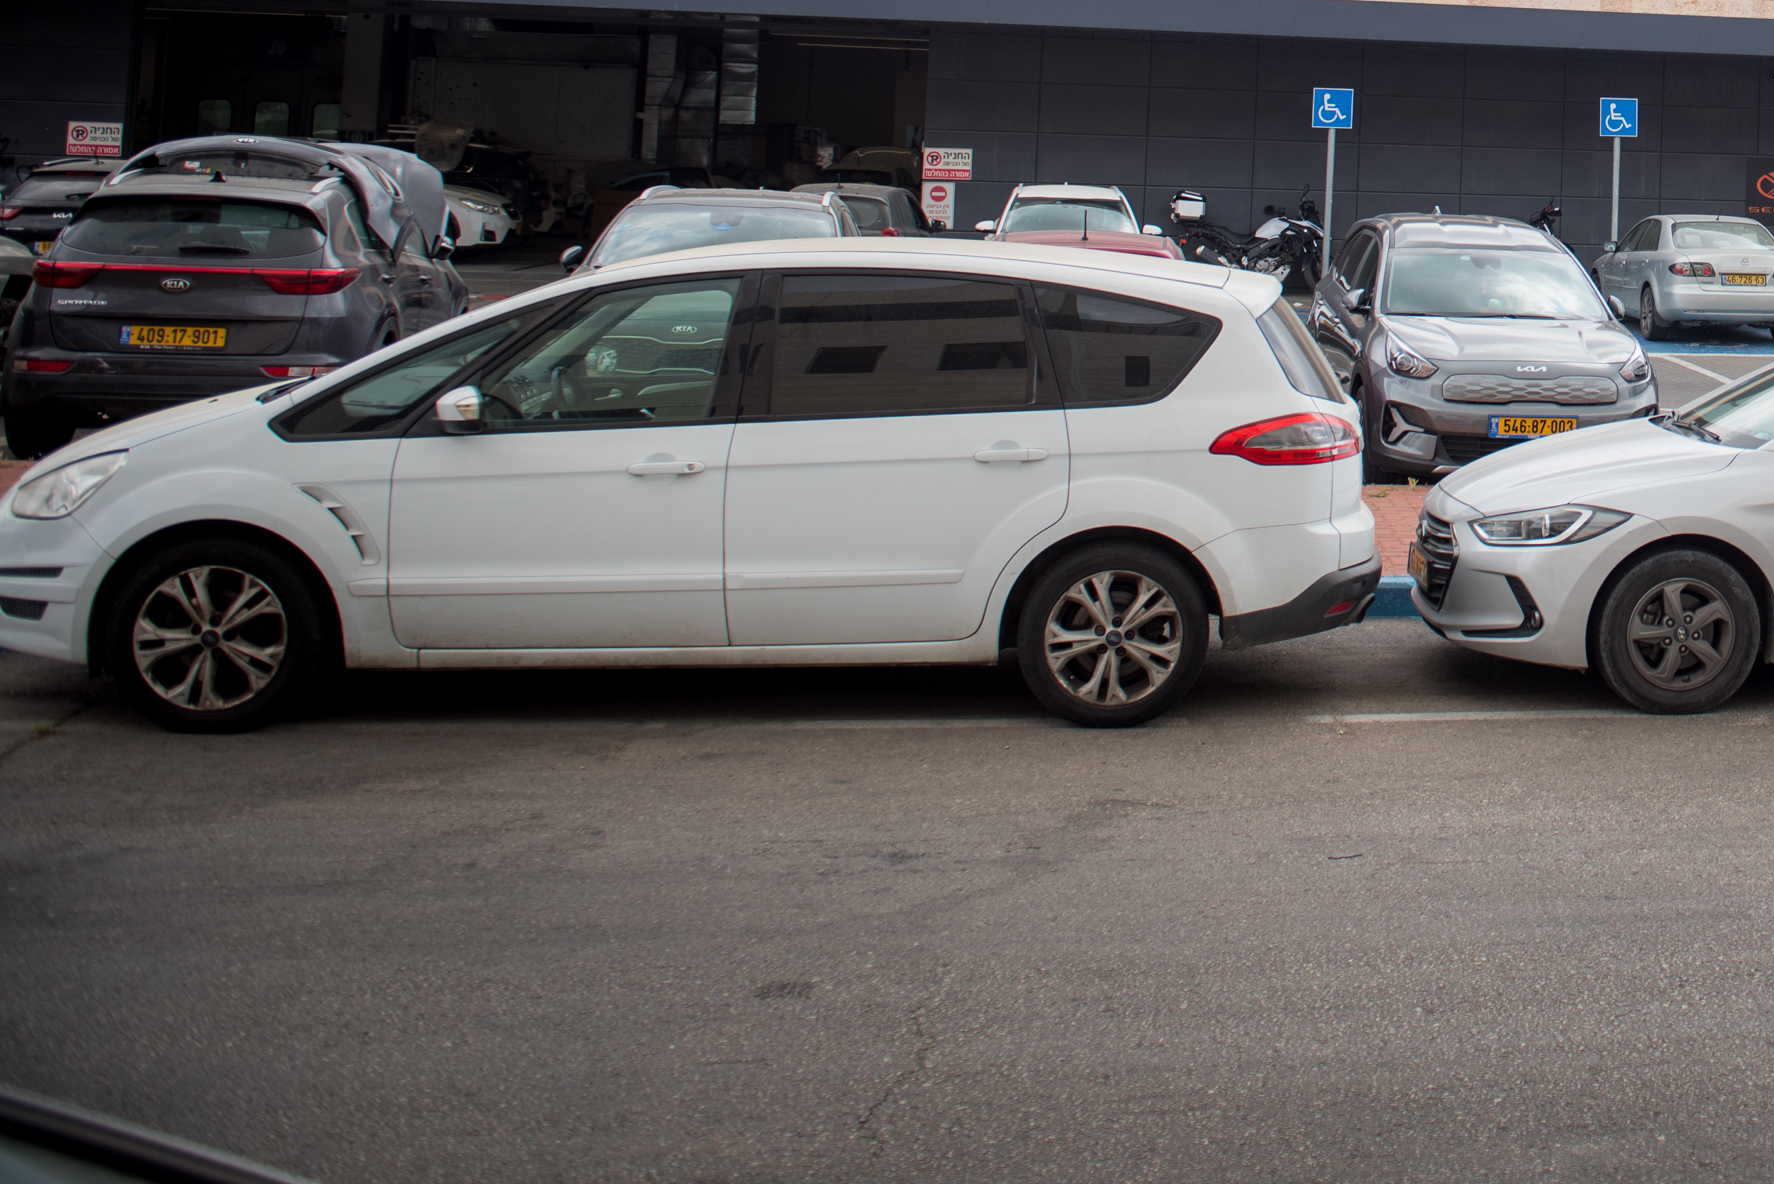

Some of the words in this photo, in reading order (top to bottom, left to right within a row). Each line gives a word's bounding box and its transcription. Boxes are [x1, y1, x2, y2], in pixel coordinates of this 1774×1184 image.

[90, 126, 120, 135] החניה
[97, 146, 119, 154] אסורה
[943, 151, 970, 160] החניה
[926, 169, 949, 177] בהחלט!
[1516, 365, 1547, 373] KIA
